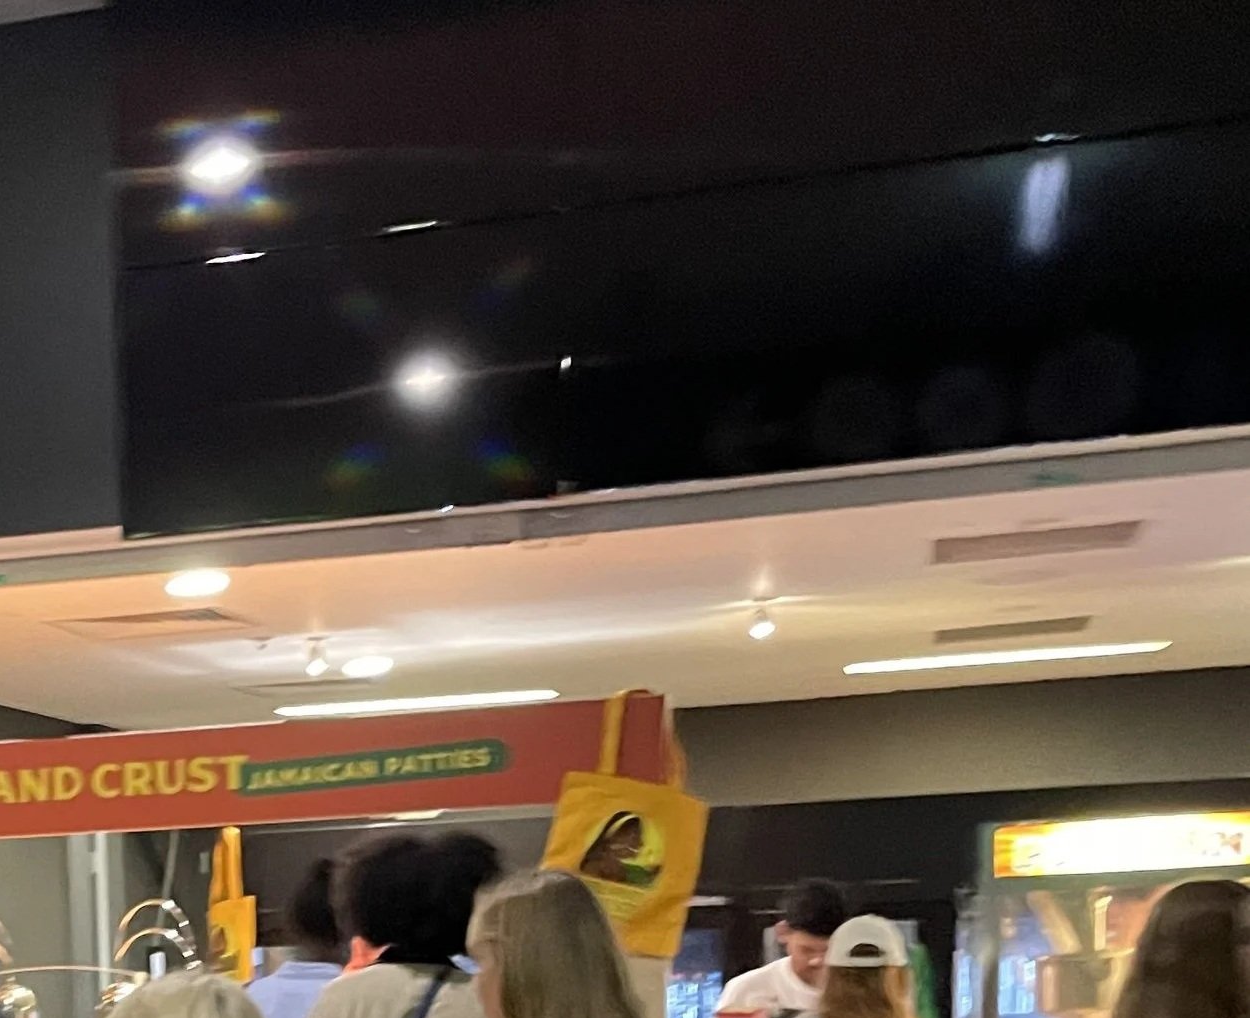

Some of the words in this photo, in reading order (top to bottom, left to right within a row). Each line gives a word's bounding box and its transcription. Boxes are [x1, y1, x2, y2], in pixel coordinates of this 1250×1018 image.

[90, 755, 249, 798] CRUST
[247, 759, 380, 790] JAMAICAN
[383, 747, 492, 777] PATTIES
